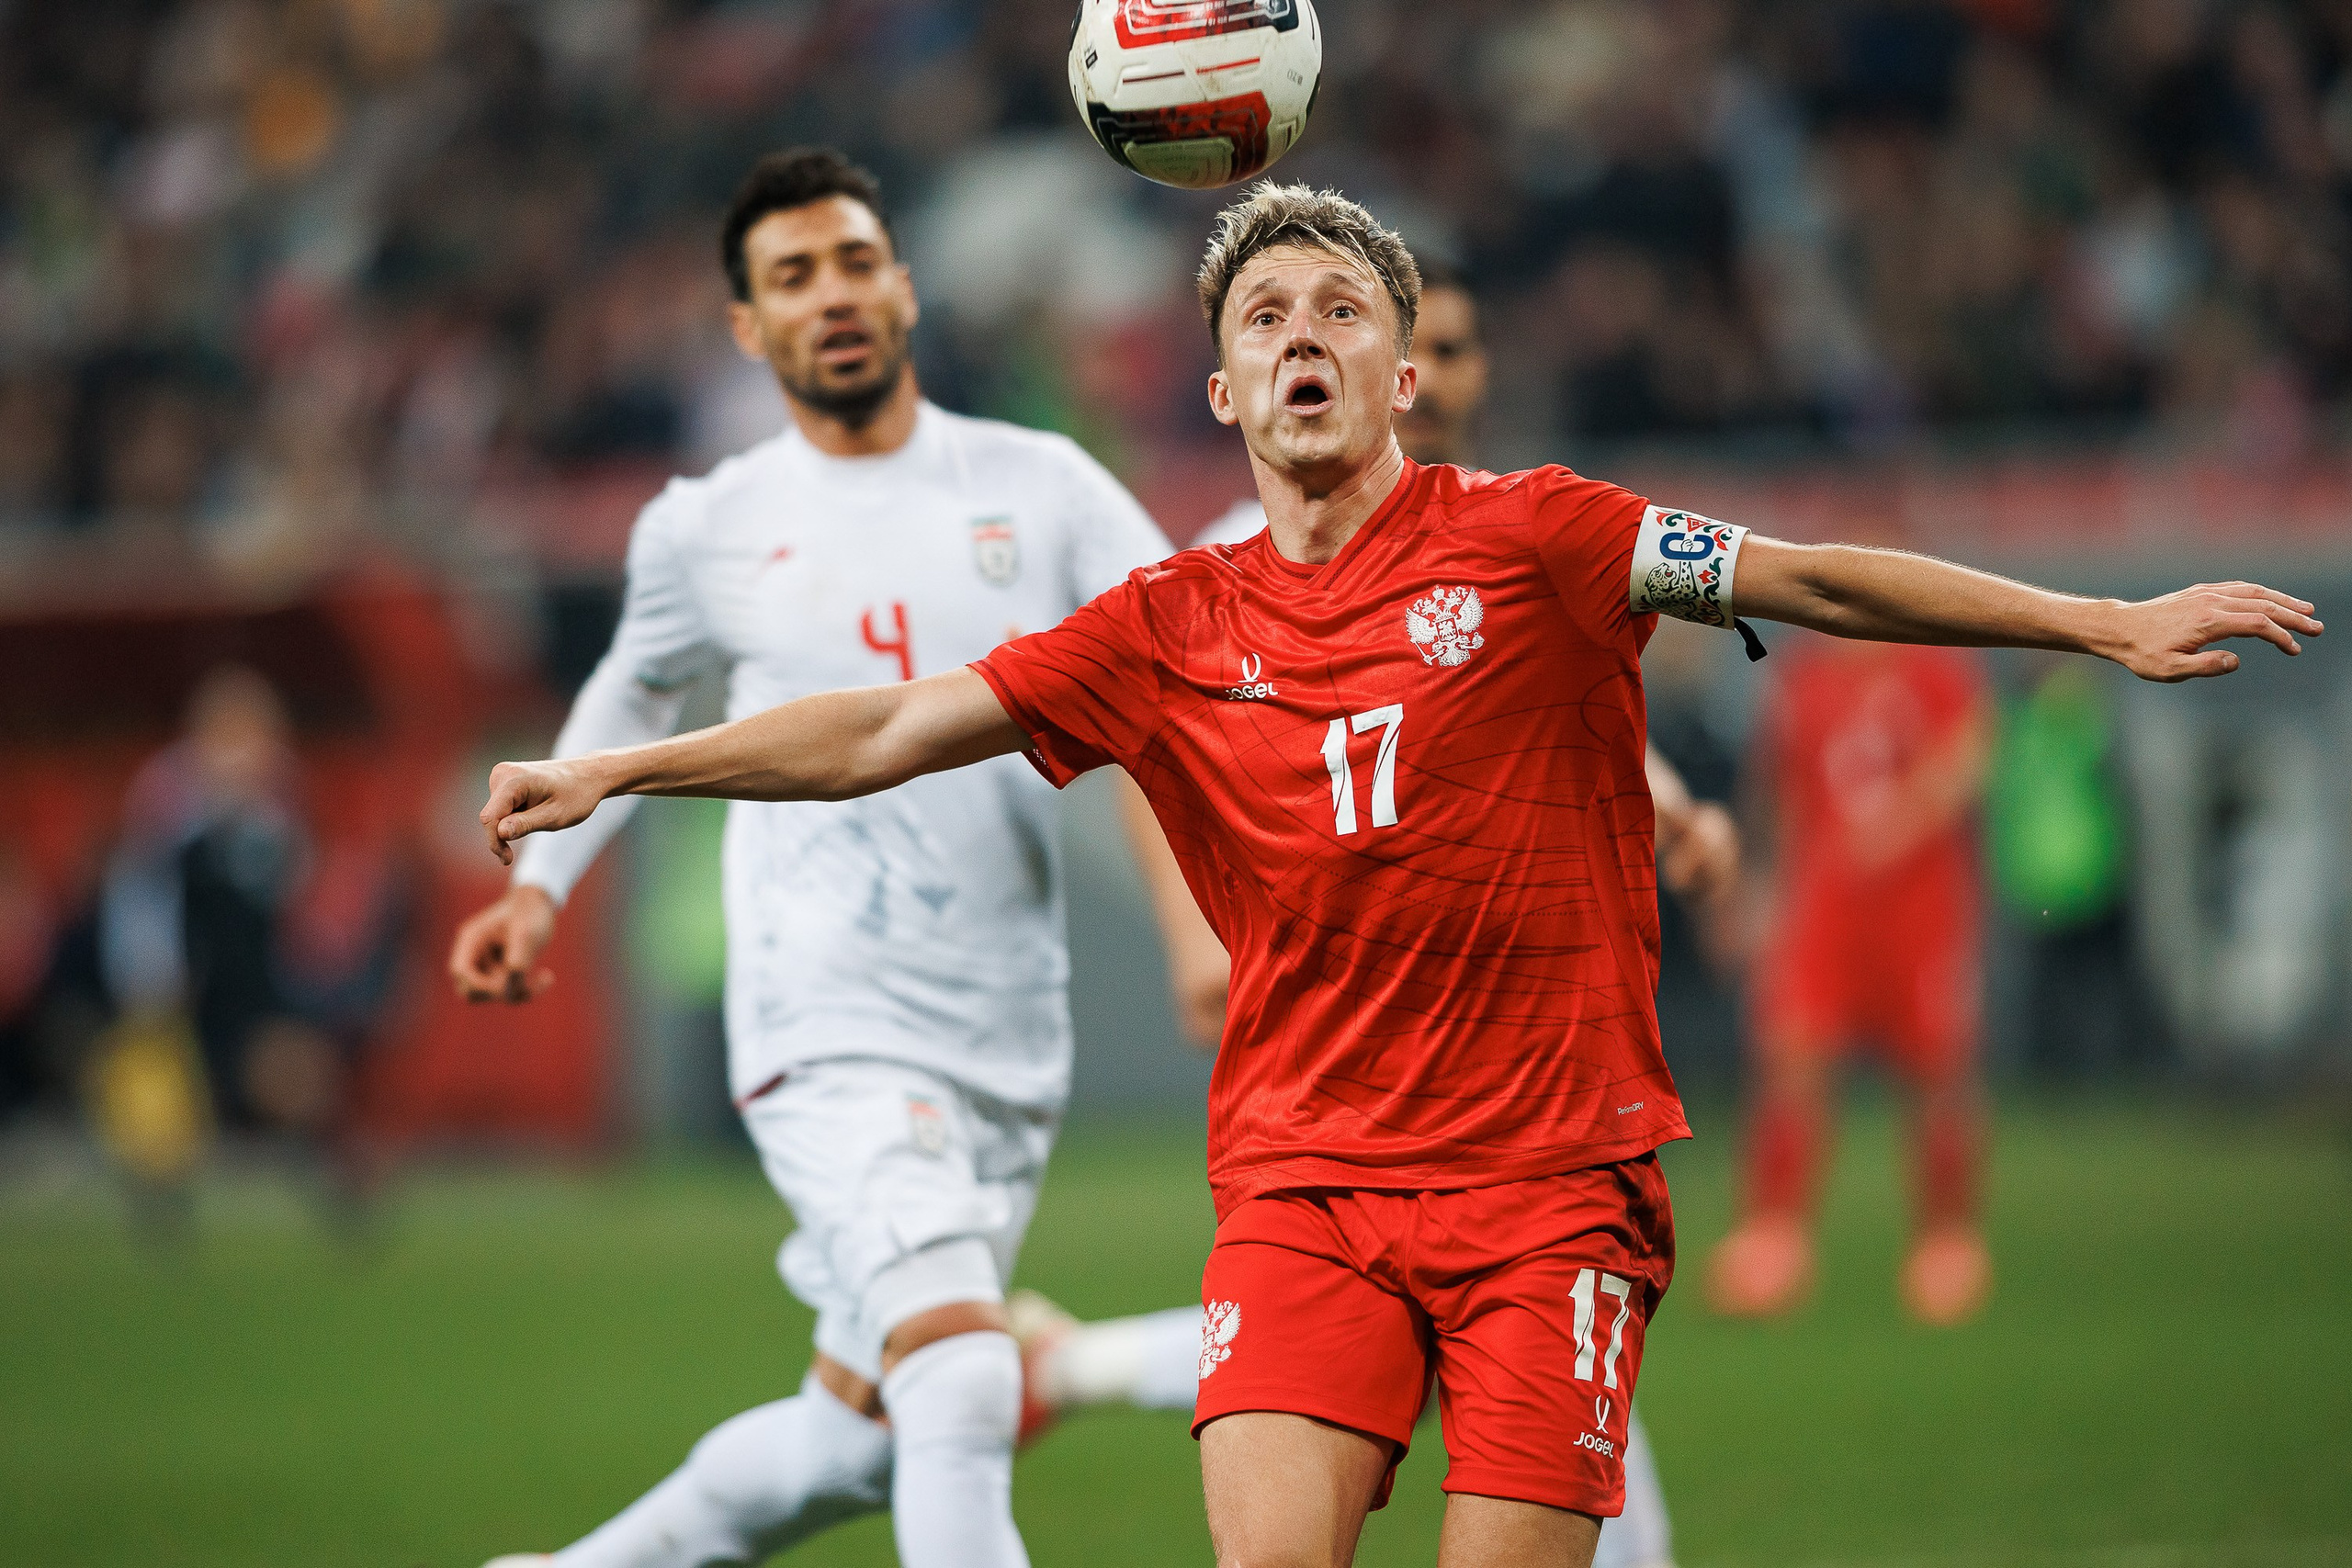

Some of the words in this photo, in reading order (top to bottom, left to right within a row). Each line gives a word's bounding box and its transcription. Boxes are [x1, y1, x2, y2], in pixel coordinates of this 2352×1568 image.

[858, 602, 915, 682] 4
[1319, 703, 1405, 837] 17
[1567, 1268, 1632, 1391] 17
